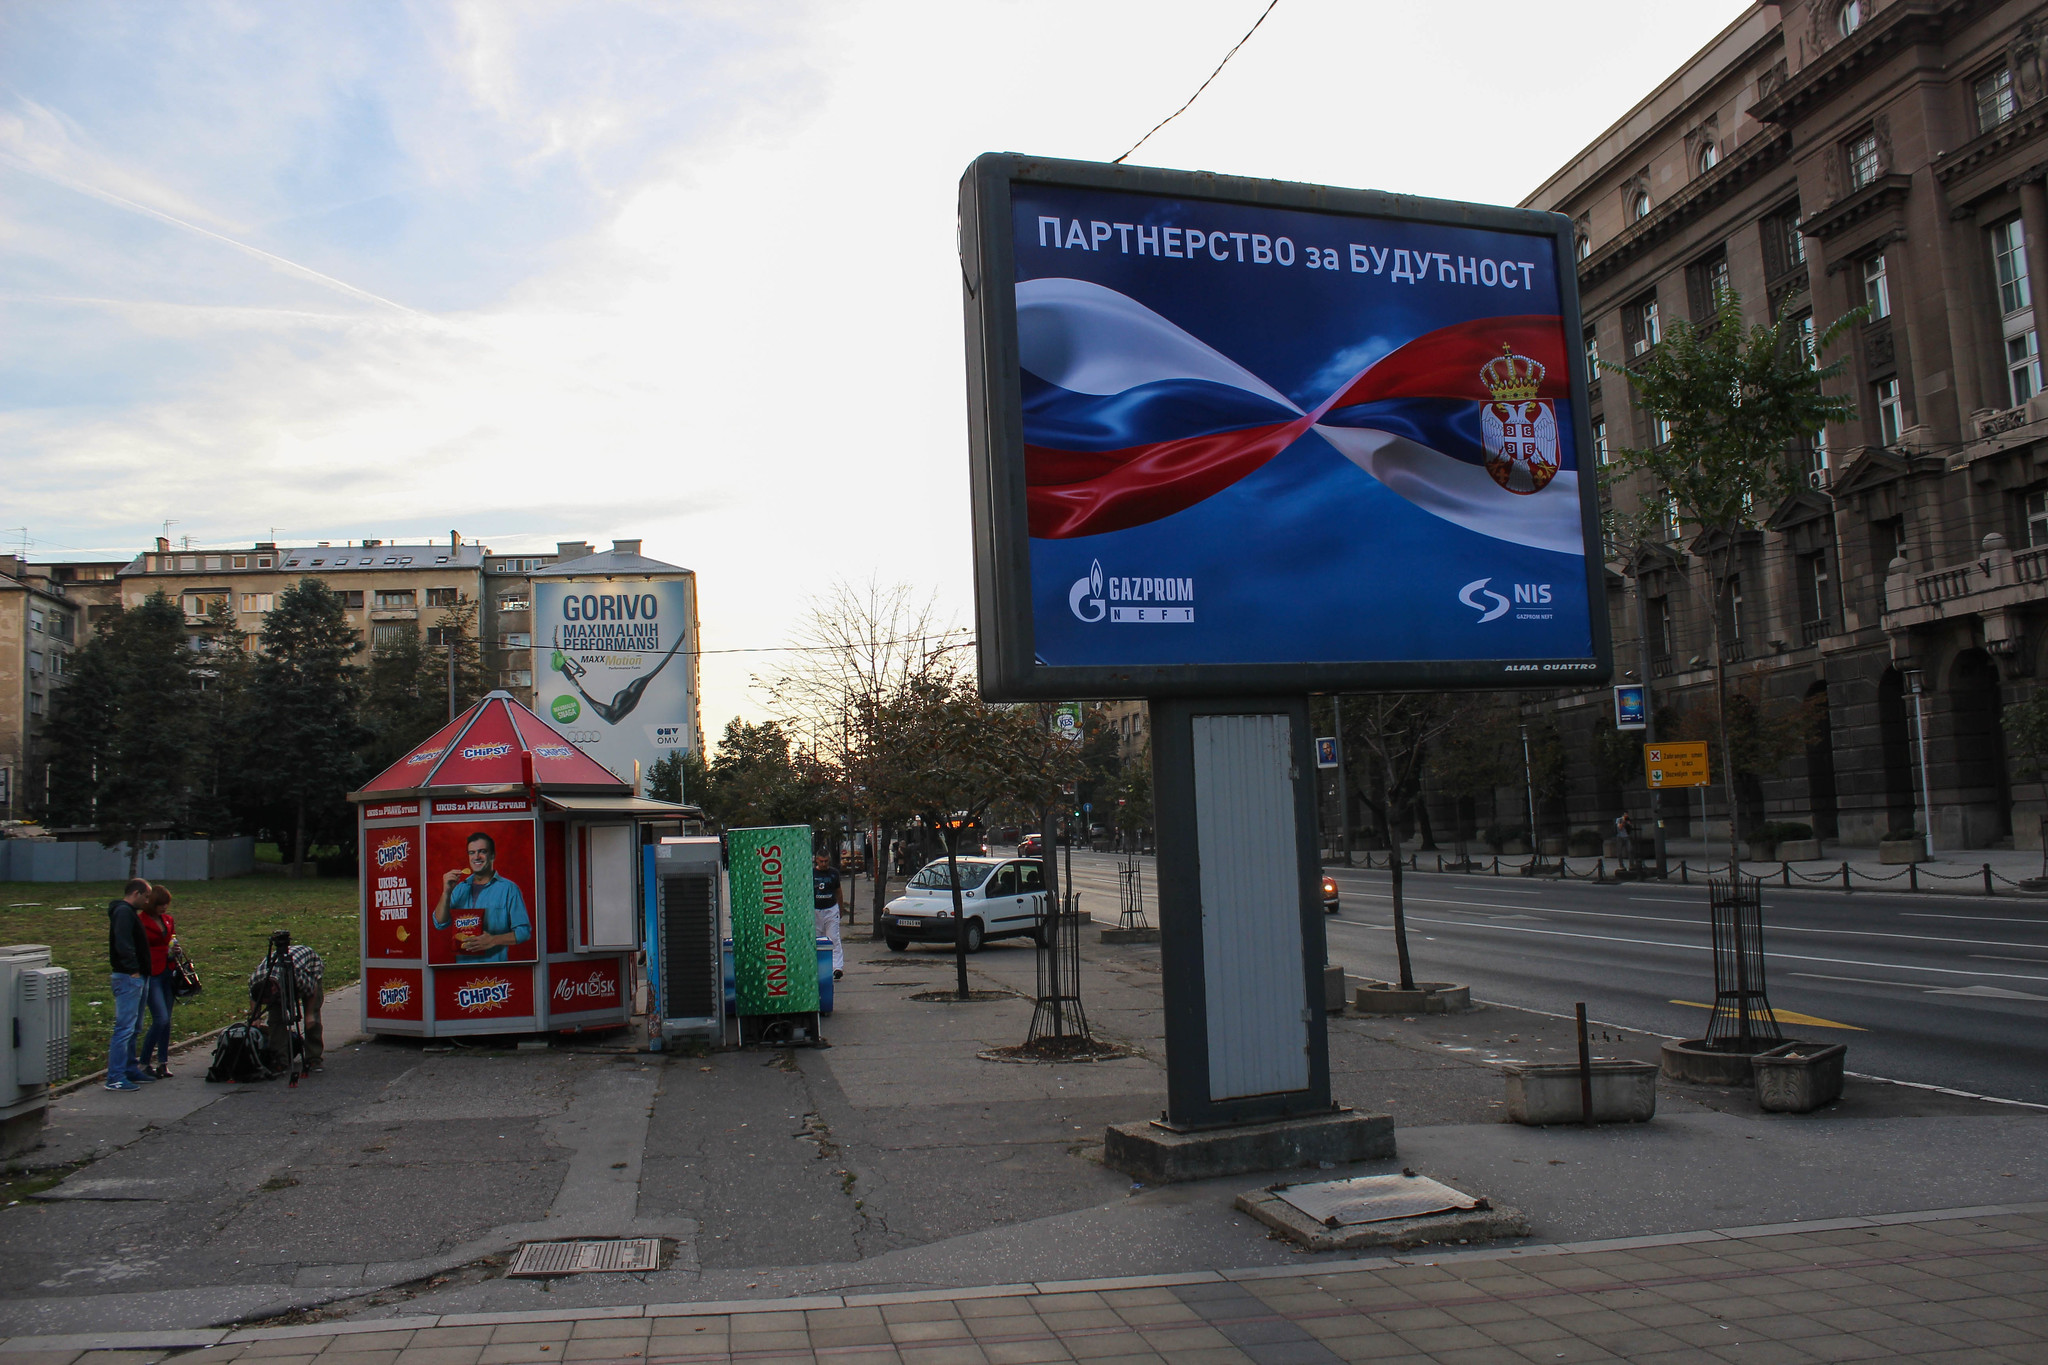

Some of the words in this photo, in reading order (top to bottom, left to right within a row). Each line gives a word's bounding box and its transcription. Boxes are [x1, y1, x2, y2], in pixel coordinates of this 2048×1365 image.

[1038, 215, 1296, 267] ПАРТНЕРСТВО
[1305, 246, 1340, 271] за
[1349, 243, 1535, 290] БУДУЋНОСТ
[1109, 577, 1194, 601] GAZPROM
[1514, 583, 1552, 604] NIS
[563, 594, 658, 621] GORIVO
[563, 623, 658, 638] MAXIMALNIH
[563, 637, 659, 650] PERFORMANSI
[557, 708, 577, 719] SNAGA
[657, 737, 679, 745] OMV
[366, 809, 379, 817] UKUS
[384, 805, 402, 815] PRAVE
[401, 806, 418, 814] STVARI
[436, 803, 457, 812] UKUS
[467, 800, 499, 810] PRAVE
[378, 876, 398, 889] UKUS
[398, 878, 407, 888] ZA
[756, 845, 785, 915] MILOŠ
[375, 888, 413, 907] PRAVE
[380, 908, 408, 921] STVARI
[765, 923, 788, 997] KNJAZ
